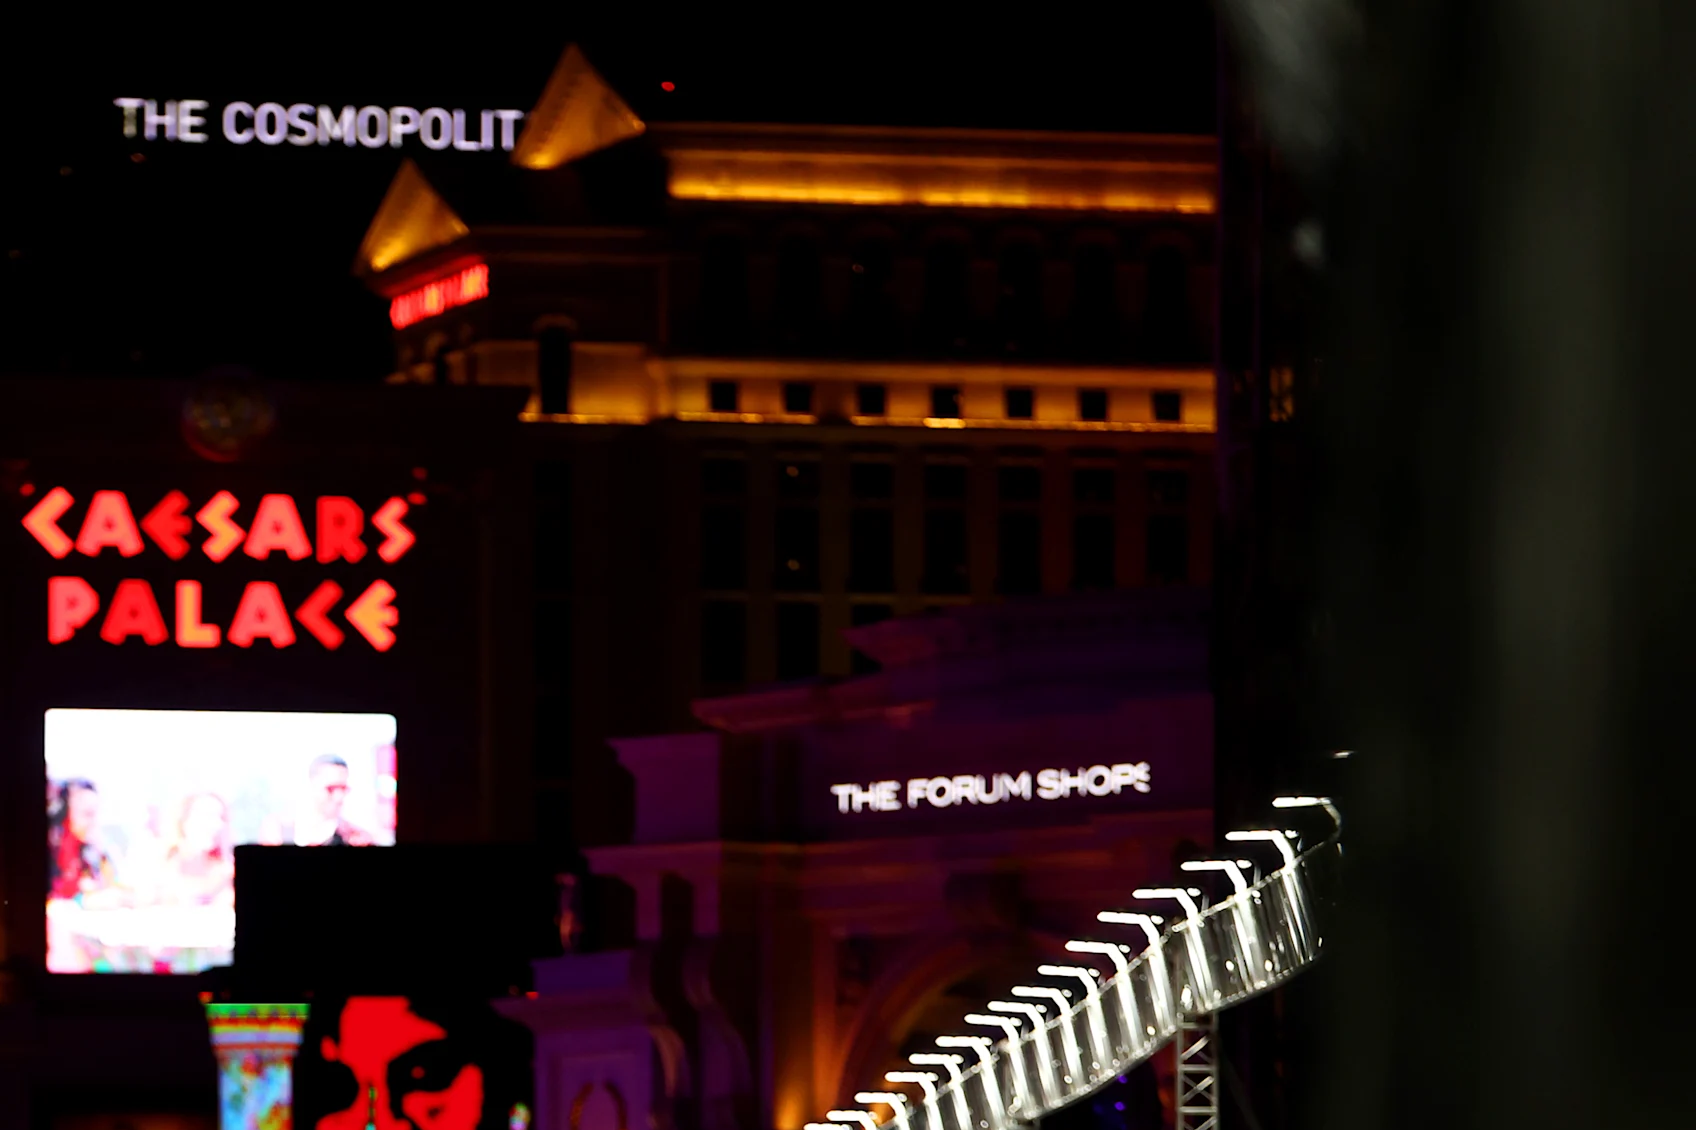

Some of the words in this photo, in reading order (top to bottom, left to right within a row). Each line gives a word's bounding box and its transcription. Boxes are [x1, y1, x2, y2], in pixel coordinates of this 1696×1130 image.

[115, 97, 208, 143] THE
[223, 101, 522, 151] COSMOPOLIT
[22, 486, 417, 563] CAESARS
[48, 576, 400, 652] PALACE
[831, 780, 902, 814] THE
[907, 770, 1033, 809] FORUM
